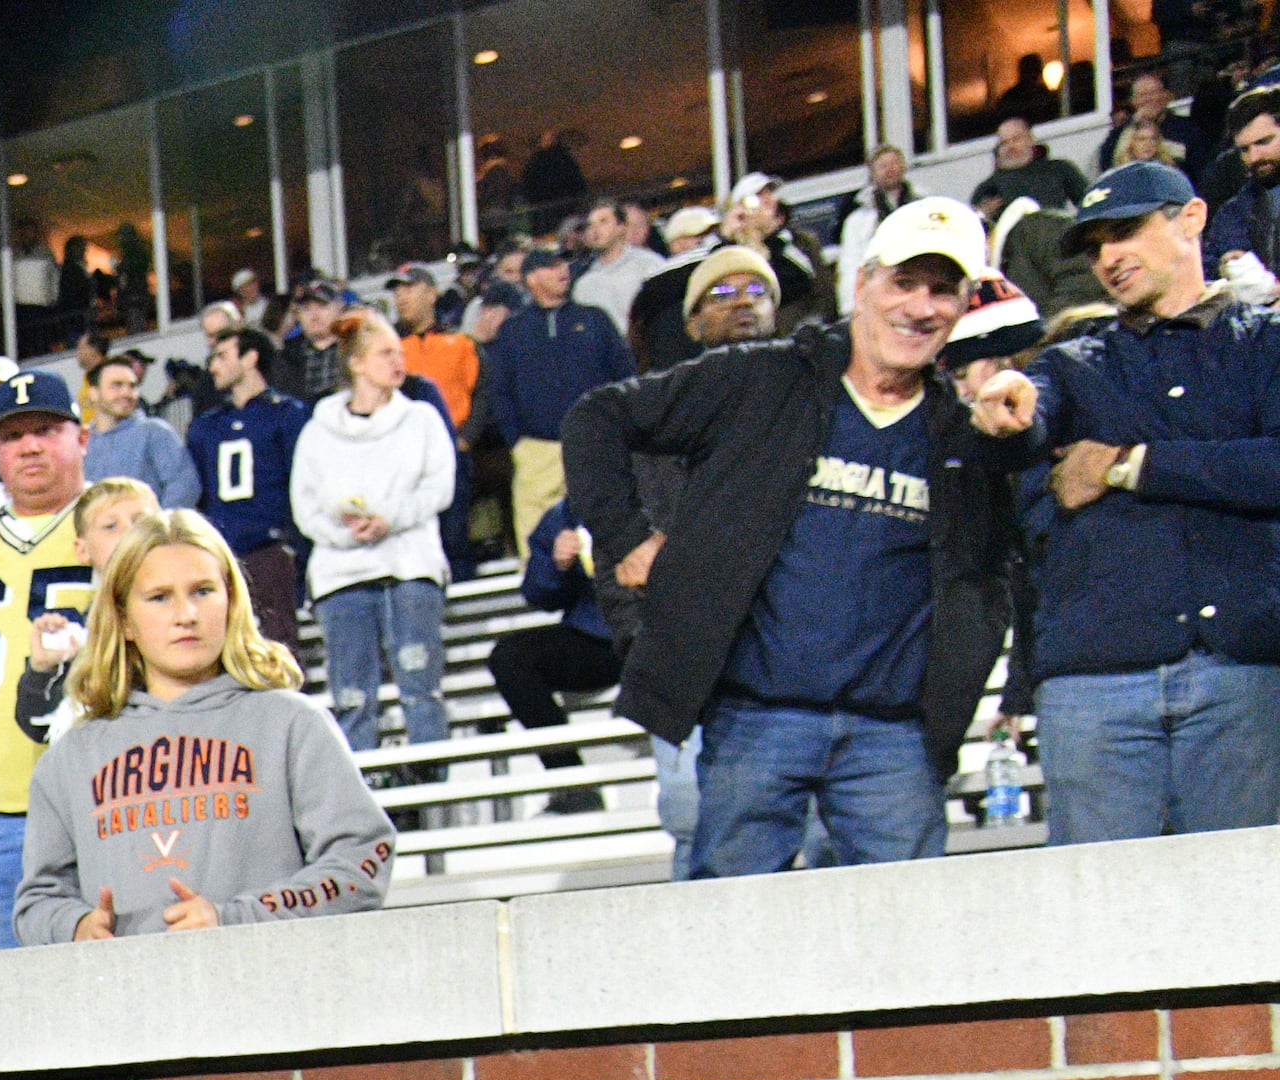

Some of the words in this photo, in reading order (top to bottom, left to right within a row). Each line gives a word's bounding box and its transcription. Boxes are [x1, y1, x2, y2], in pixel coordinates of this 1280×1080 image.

[9, 373, 35, 405] T
[91, 734, 257, 808] VIRGINIA
[97, 792, 250, 841] CAVALIERS
